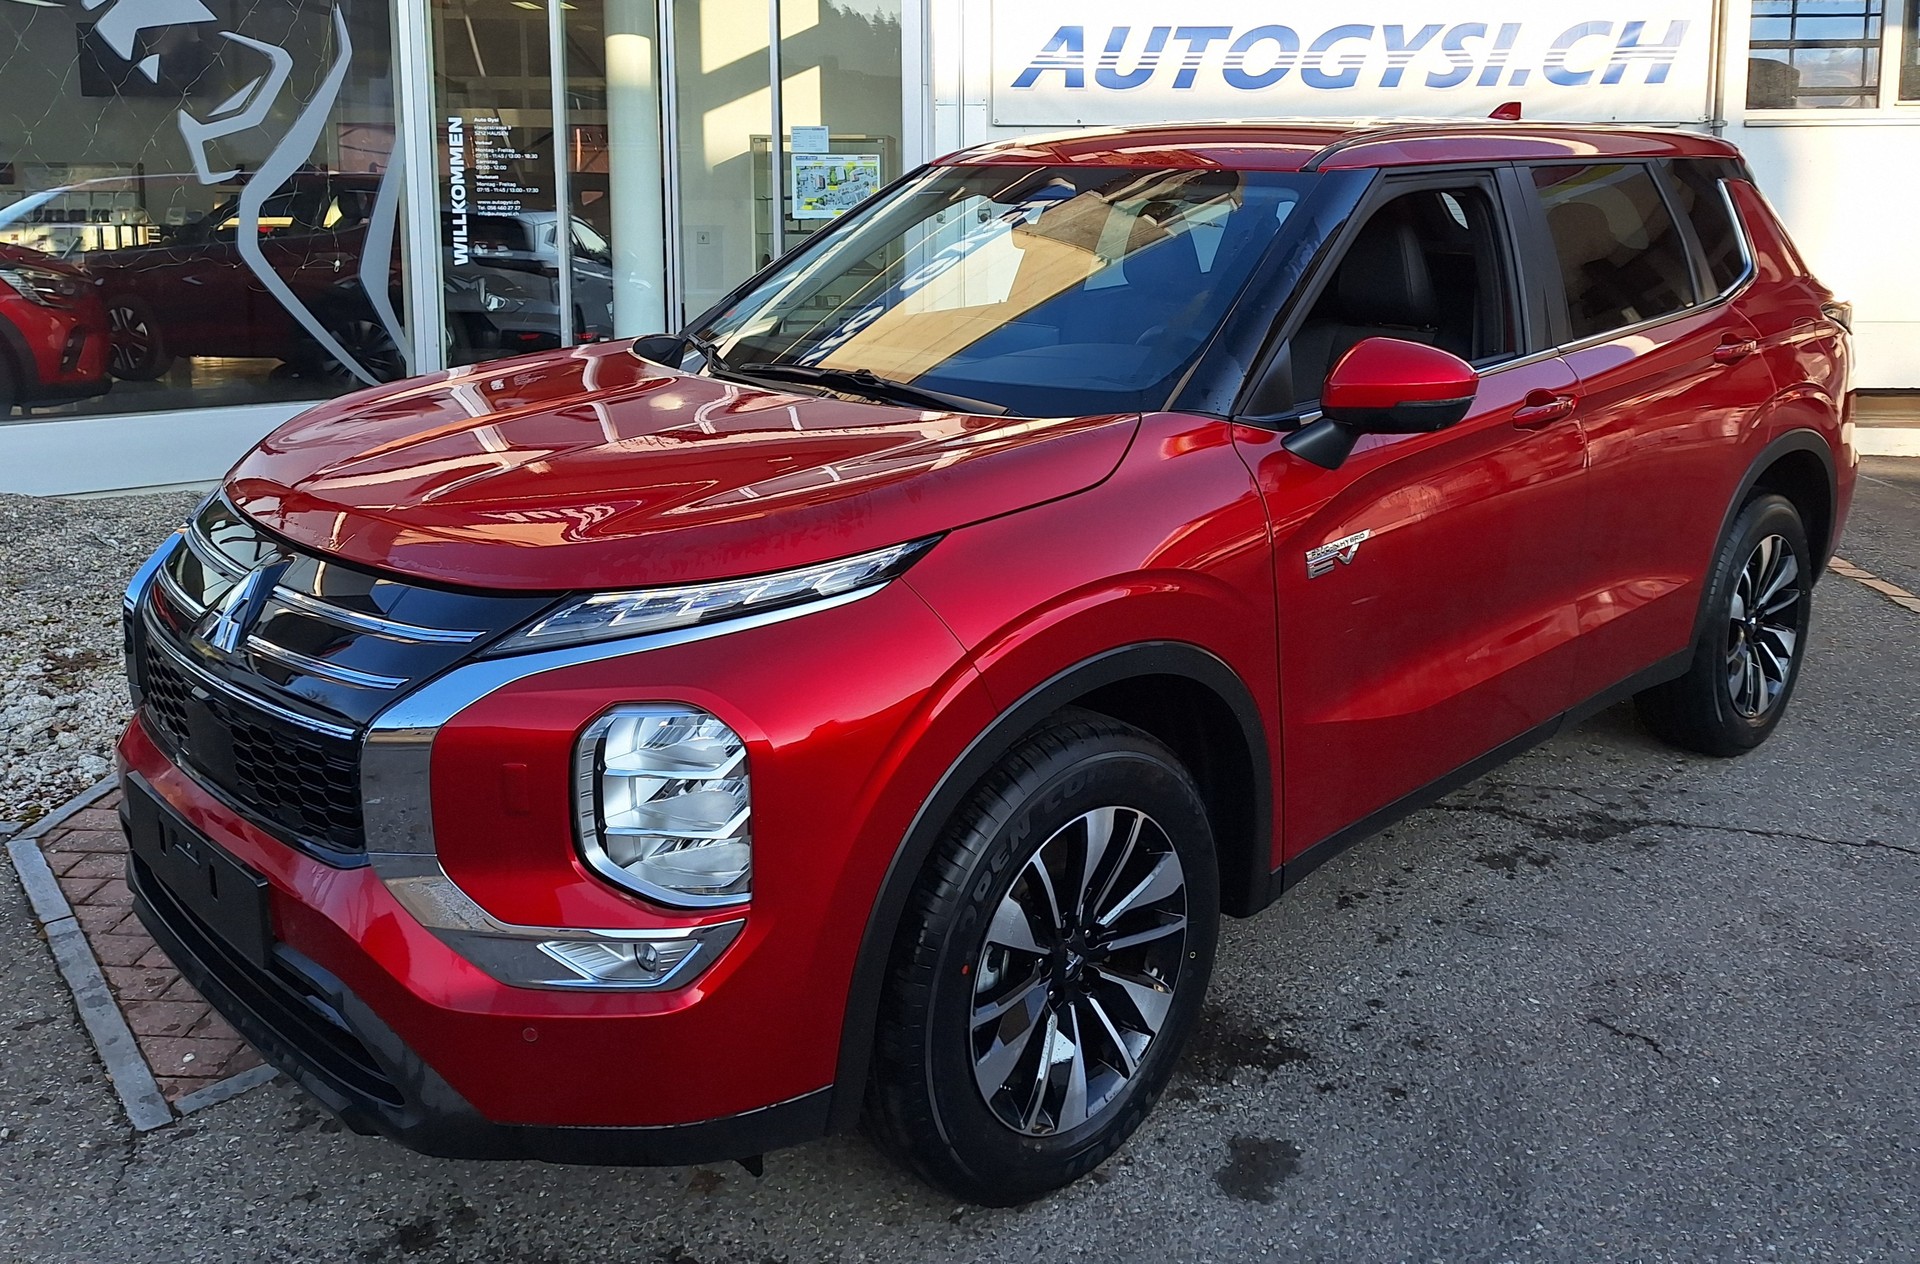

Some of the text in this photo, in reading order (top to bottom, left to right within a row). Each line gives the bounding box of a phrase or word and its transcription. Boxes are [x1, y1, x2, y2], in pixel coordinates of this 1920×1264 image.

[1011, 20, 1690, 90] AUTOGYSI.CH
[448, 117, 469, 266] WILLKOMMEN
[1306, 542, 1360, 580] EV
[1340, 532, 1365, 548] HYBRID
